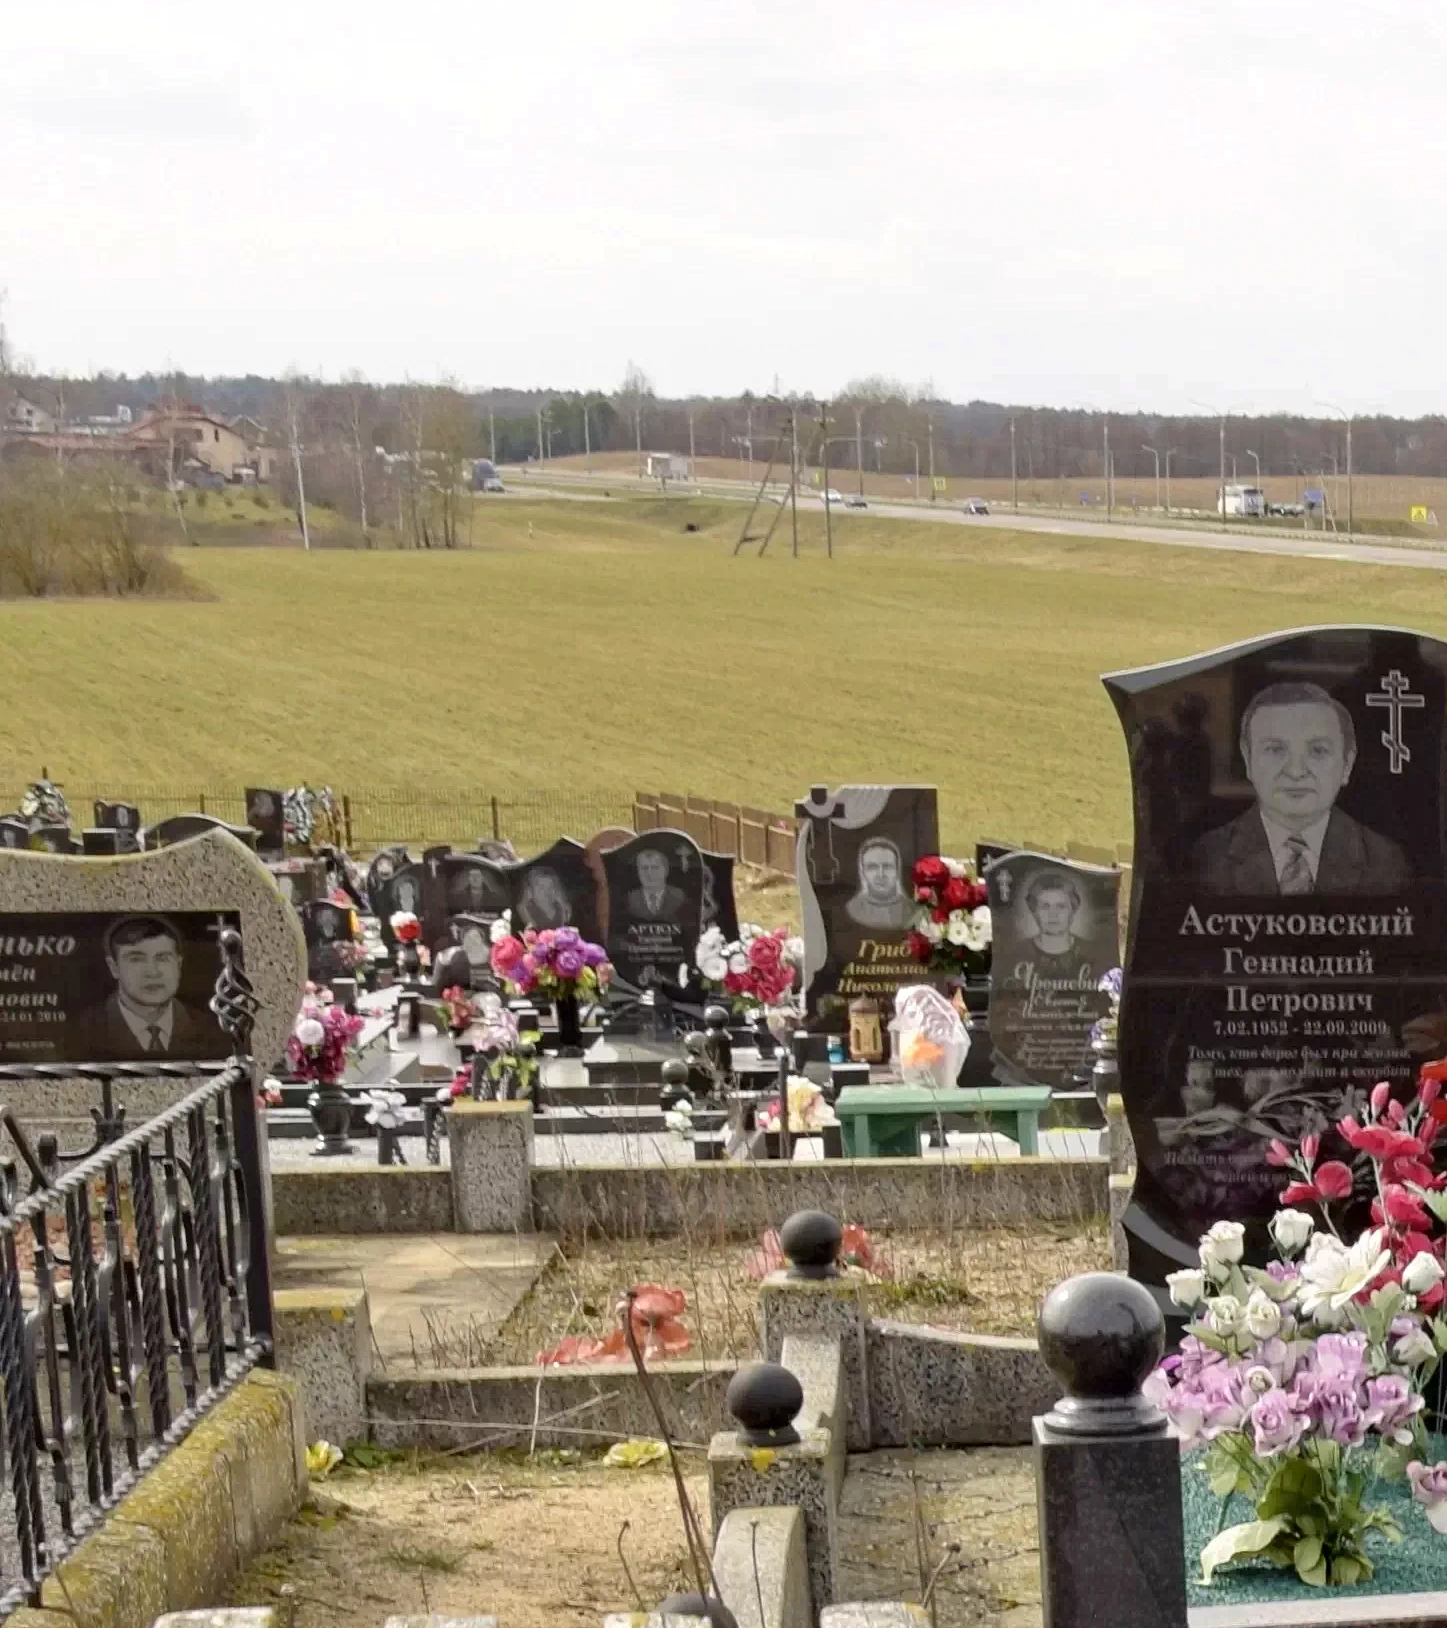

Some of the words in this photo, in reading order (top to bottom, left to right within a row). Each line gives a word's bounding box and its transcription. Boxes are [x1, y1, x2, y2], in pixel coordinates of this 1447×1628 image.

[1178, 903, 1415, 942] Астуковский
[1223, 947, 1375, 978] Геннадий
[1226, 985, 1374, 1017] Петрович
